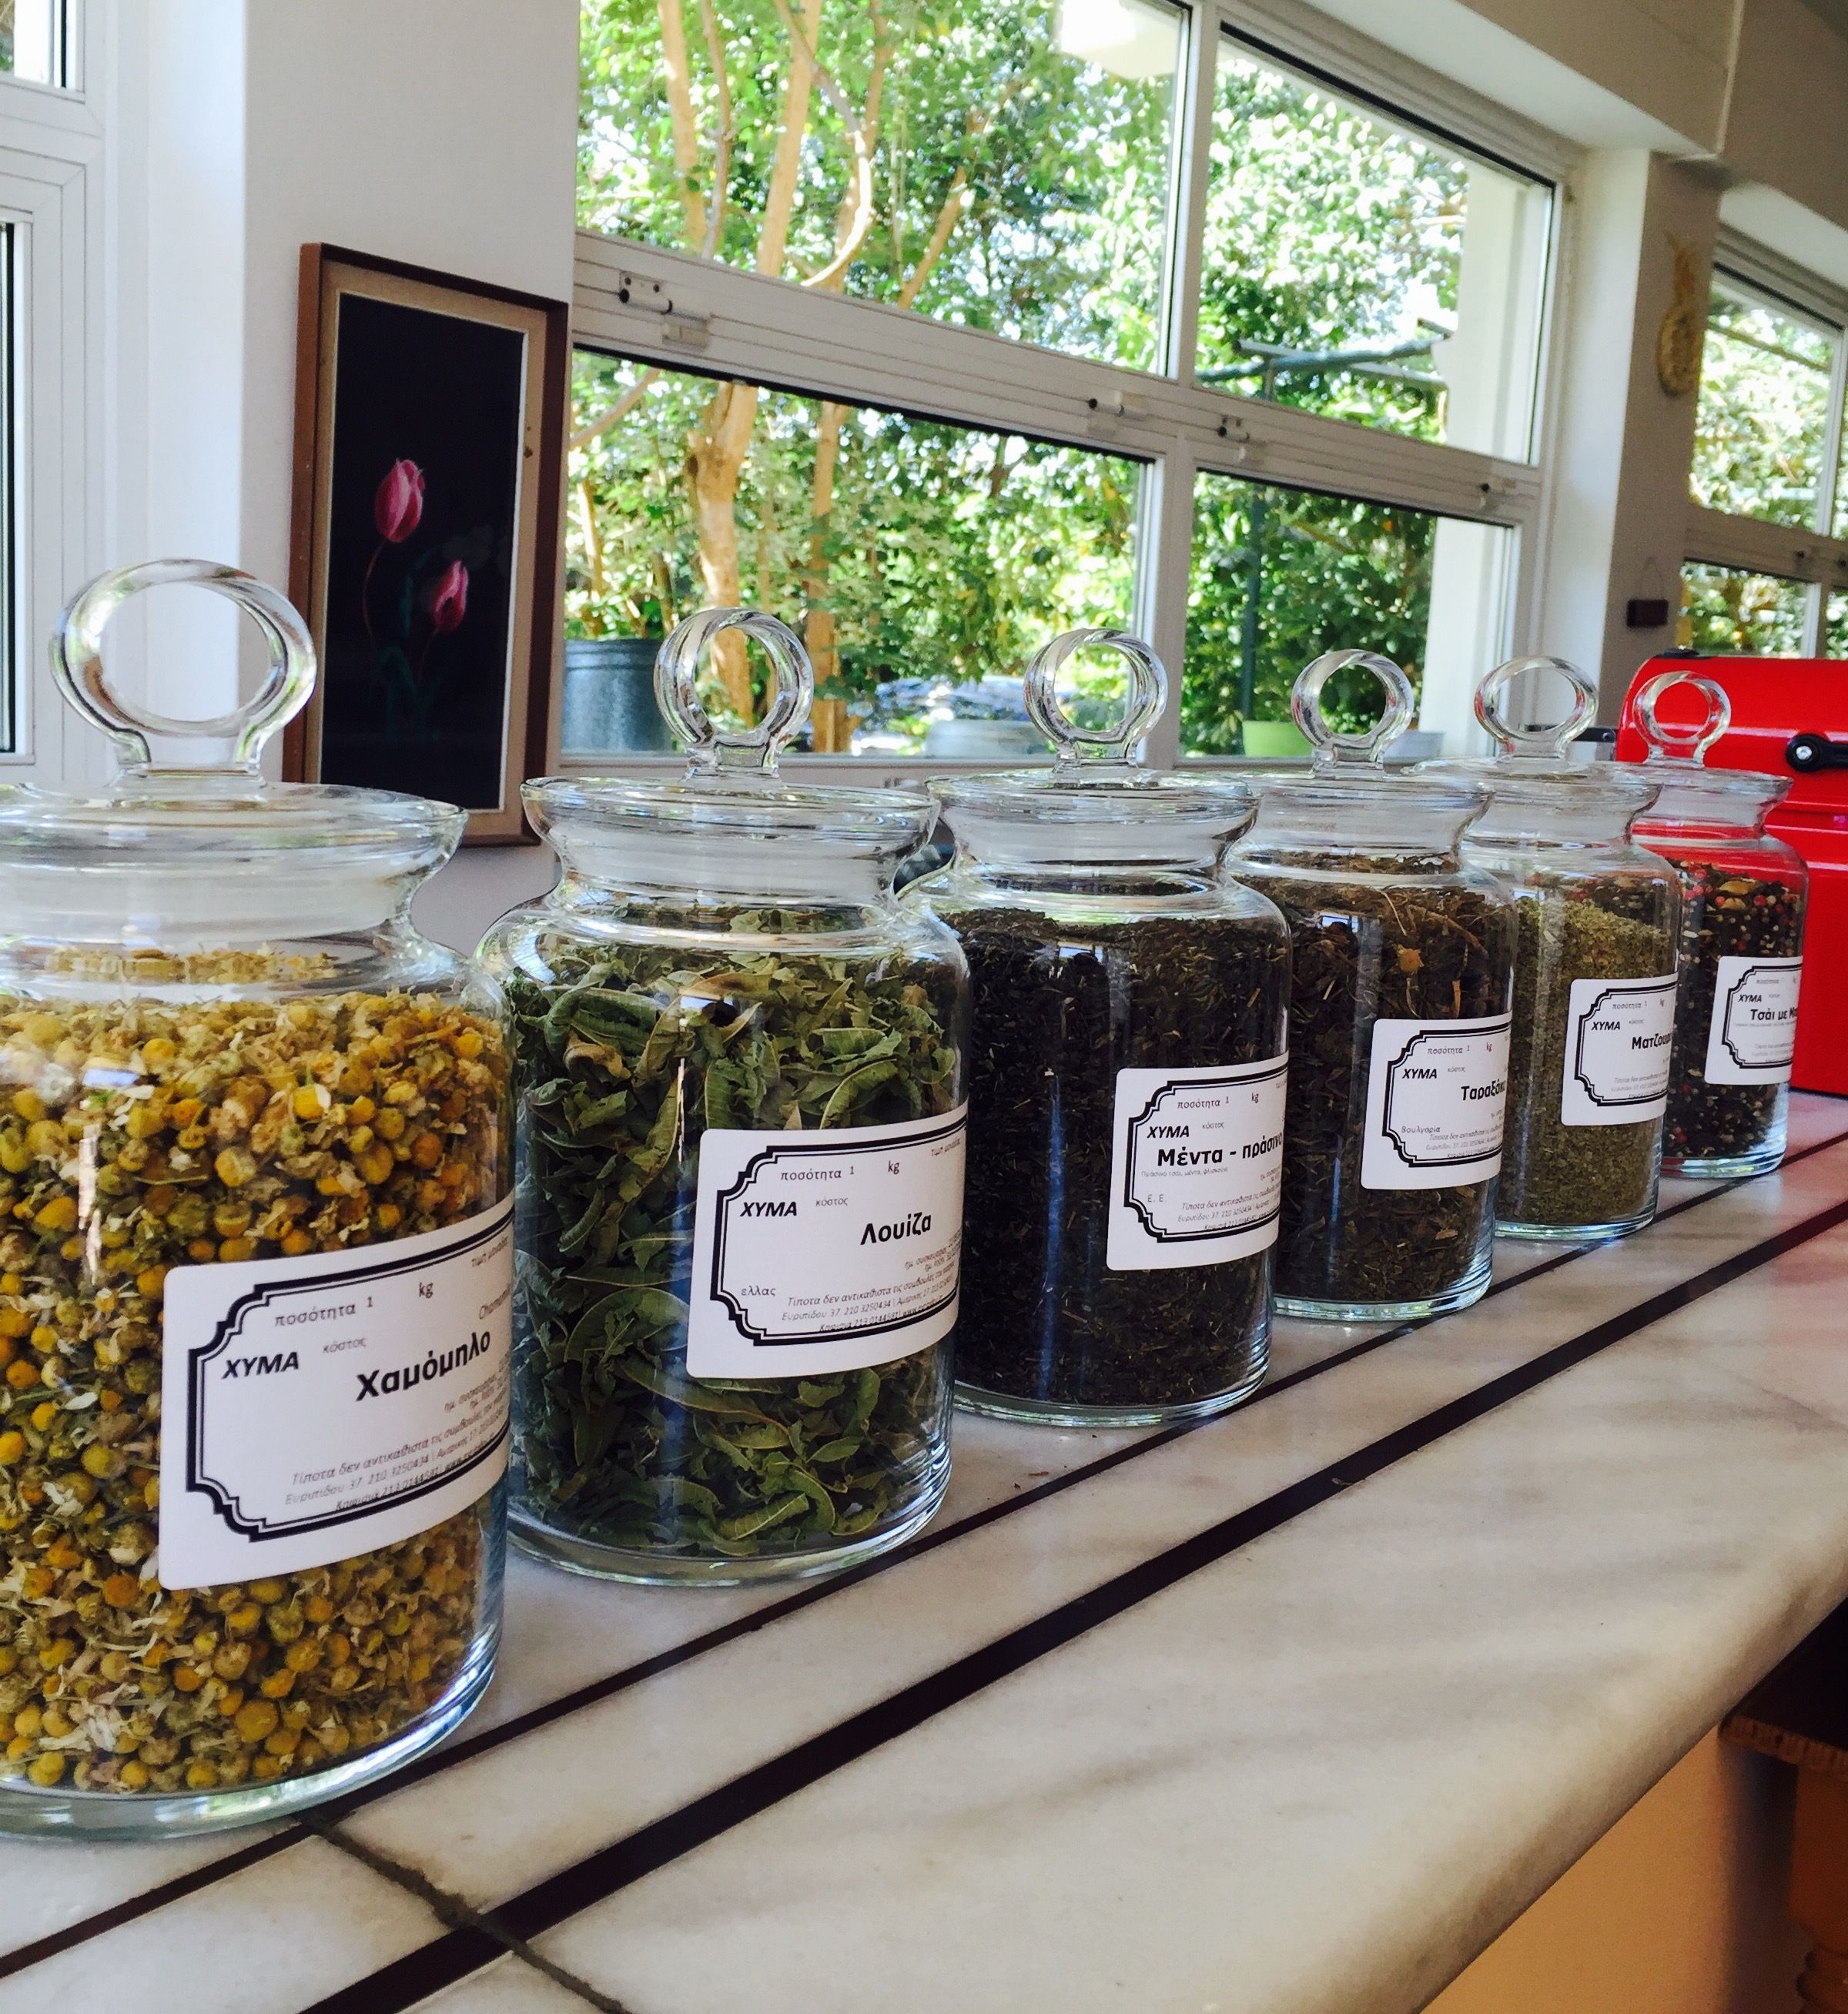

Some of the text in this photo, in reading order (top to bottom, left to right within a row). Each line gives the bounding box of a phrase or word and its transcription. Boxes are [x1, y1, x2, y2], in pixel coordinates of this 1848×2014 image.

[1750, 1007, 1775, 1021] Τσάι
[1777, 1010, 1788, 1021] με
[1591, 1021, 1621, 1031] ΧΥΜΑ
[1401, 1068, 1438, 1079] ΧΥΜΑ
[1177, 1096, 1230, 1109] ποσότητα 1
[1251, 1092, 1259, 1104] kg
[1147, 1126, 1190, 1139] ΧΥΜΑ
[1157, 1146, 1224, 1166] Μέντα
[781, 1166, 855, 1182] ποσότητα 1
[888, 1160, 900, 1175] kg
[740, 1196, 848, 1217] ΧΥΜΑ κόστος
[860, 1211, 932, 1246] Λουίζα
[418, 1281, 434, 1300] kg
[822, 1294, 839, 1304] δεν
[274, 1296, 373, 1327] ποσότητα 1
[844, 1305, 859, 1316] 210
[222, 1336, 368, 1380] ΧΥΜΑ κόστος
[356, 1330, 490, 1402] Χαμόμηλο
[338, 1462, 360, 1476] δεν
